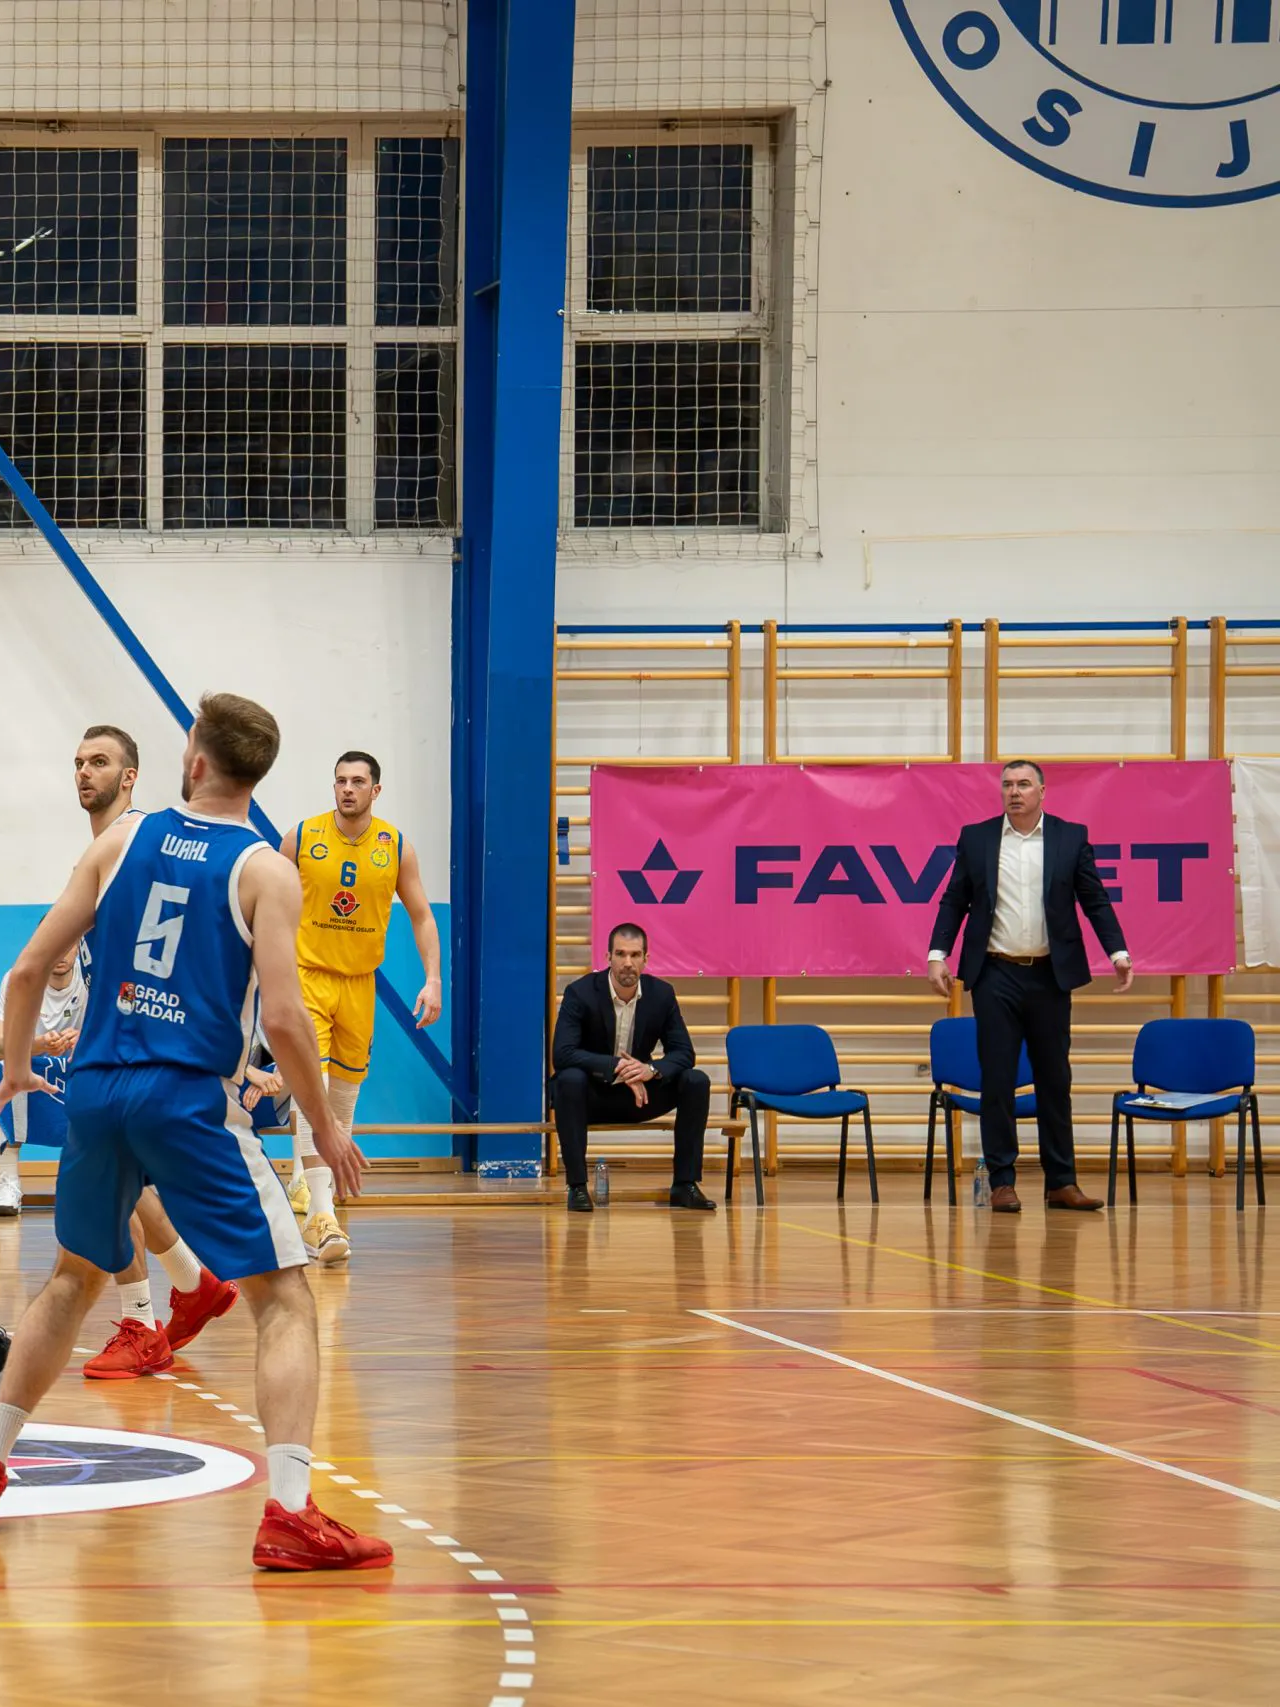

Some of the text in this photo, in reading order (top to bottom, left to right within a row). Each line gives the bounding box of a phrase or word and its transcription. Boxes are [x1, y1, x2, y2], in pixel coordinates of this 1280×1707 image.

[160, 833, 209, 862] WAHL
[340, 861, 357, 887] 6
[735, 842, 1209, 904] FAVT
[133, 881, 190, 979] 5
[134, 984, 181, 1007] GRAD
